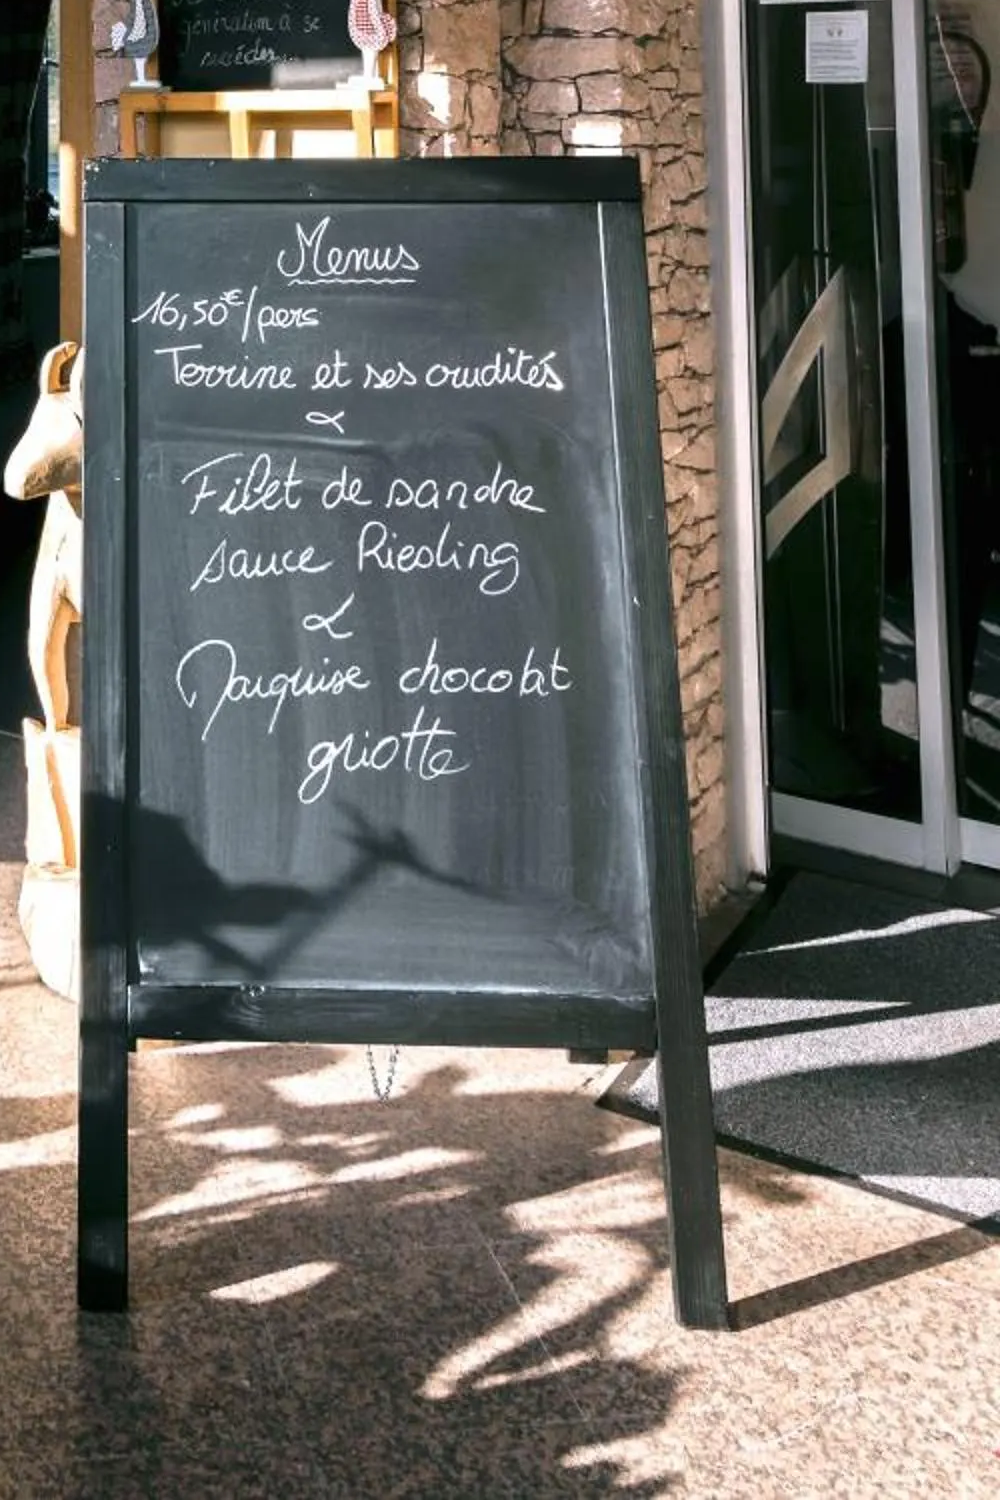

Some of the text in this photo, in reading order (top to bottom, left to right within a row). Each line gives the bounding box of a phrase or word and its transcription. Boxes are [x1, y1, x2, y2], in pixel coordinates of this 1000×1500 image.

[276, 215, 420, 278] Menus
[311, 349, 352, 391] et
[362, 361, 418, 389] ses
[425, 347, 565, 392] crudités
[180, 452, 547, 516] Filet de sandre
[189, 520, 520, 596] sauce Riesling
[398, 637, 572, 697] chocolat
[297, 705, 470, 805] griotte
